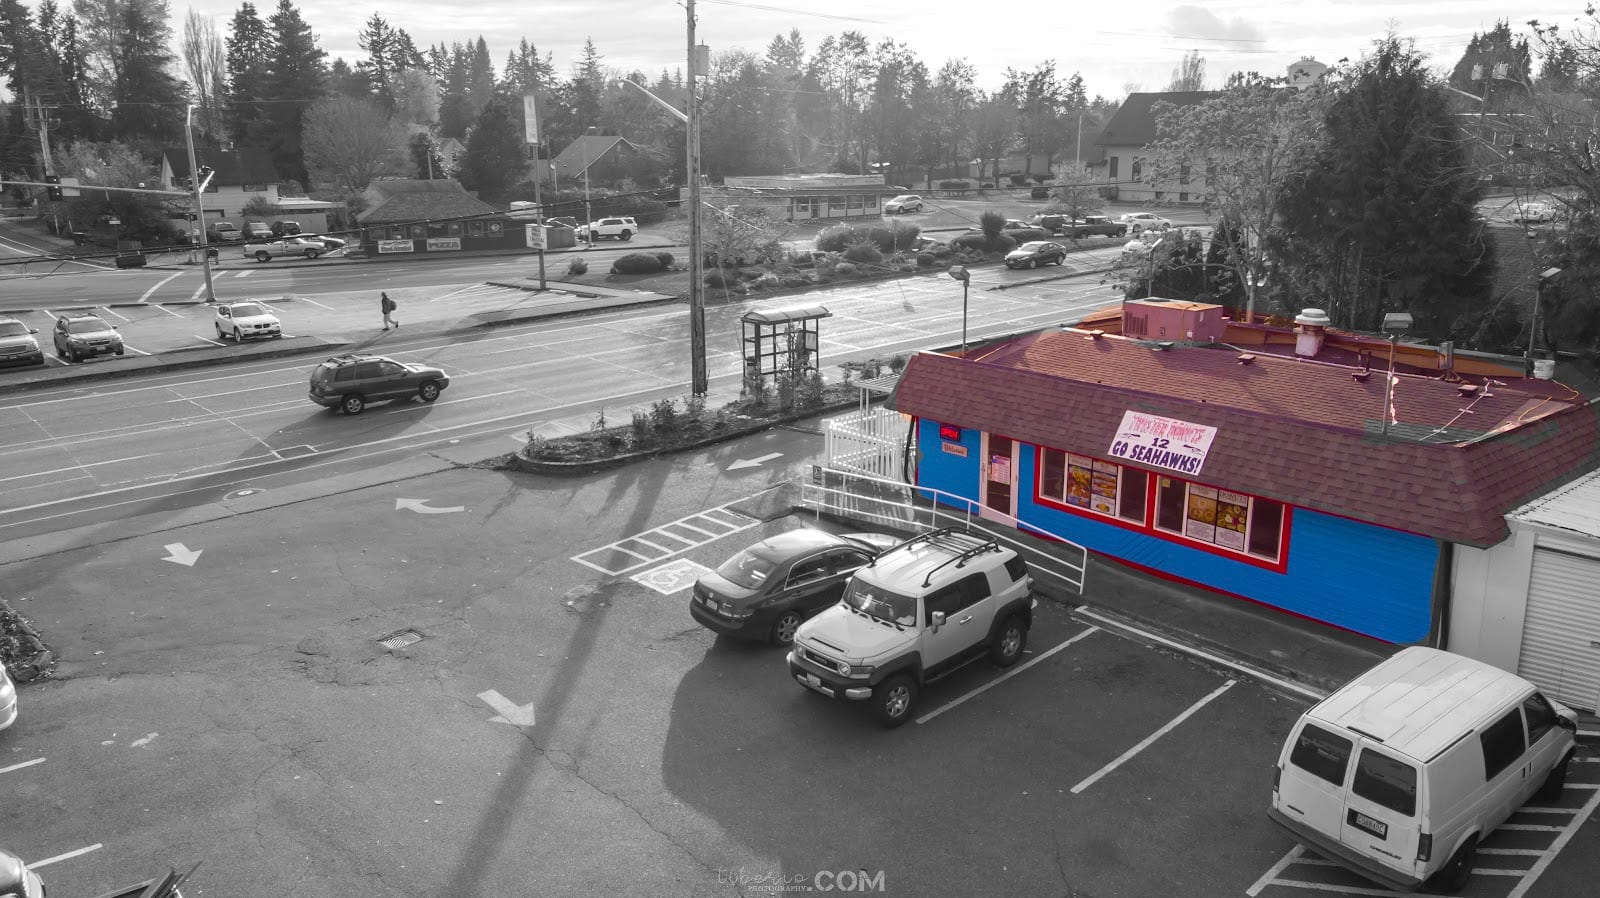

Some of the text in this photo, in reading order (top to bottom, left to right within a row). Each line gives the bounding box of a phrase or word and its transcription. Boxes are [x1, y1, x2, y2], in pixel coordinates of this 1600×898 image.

[941, 427, 958, 439] OPEN
[1152, 437, 1170, 449] 12
[1112, 440, 1129, 456] GO
[1129, 444, 1202, 473] SEAHAWKS!
